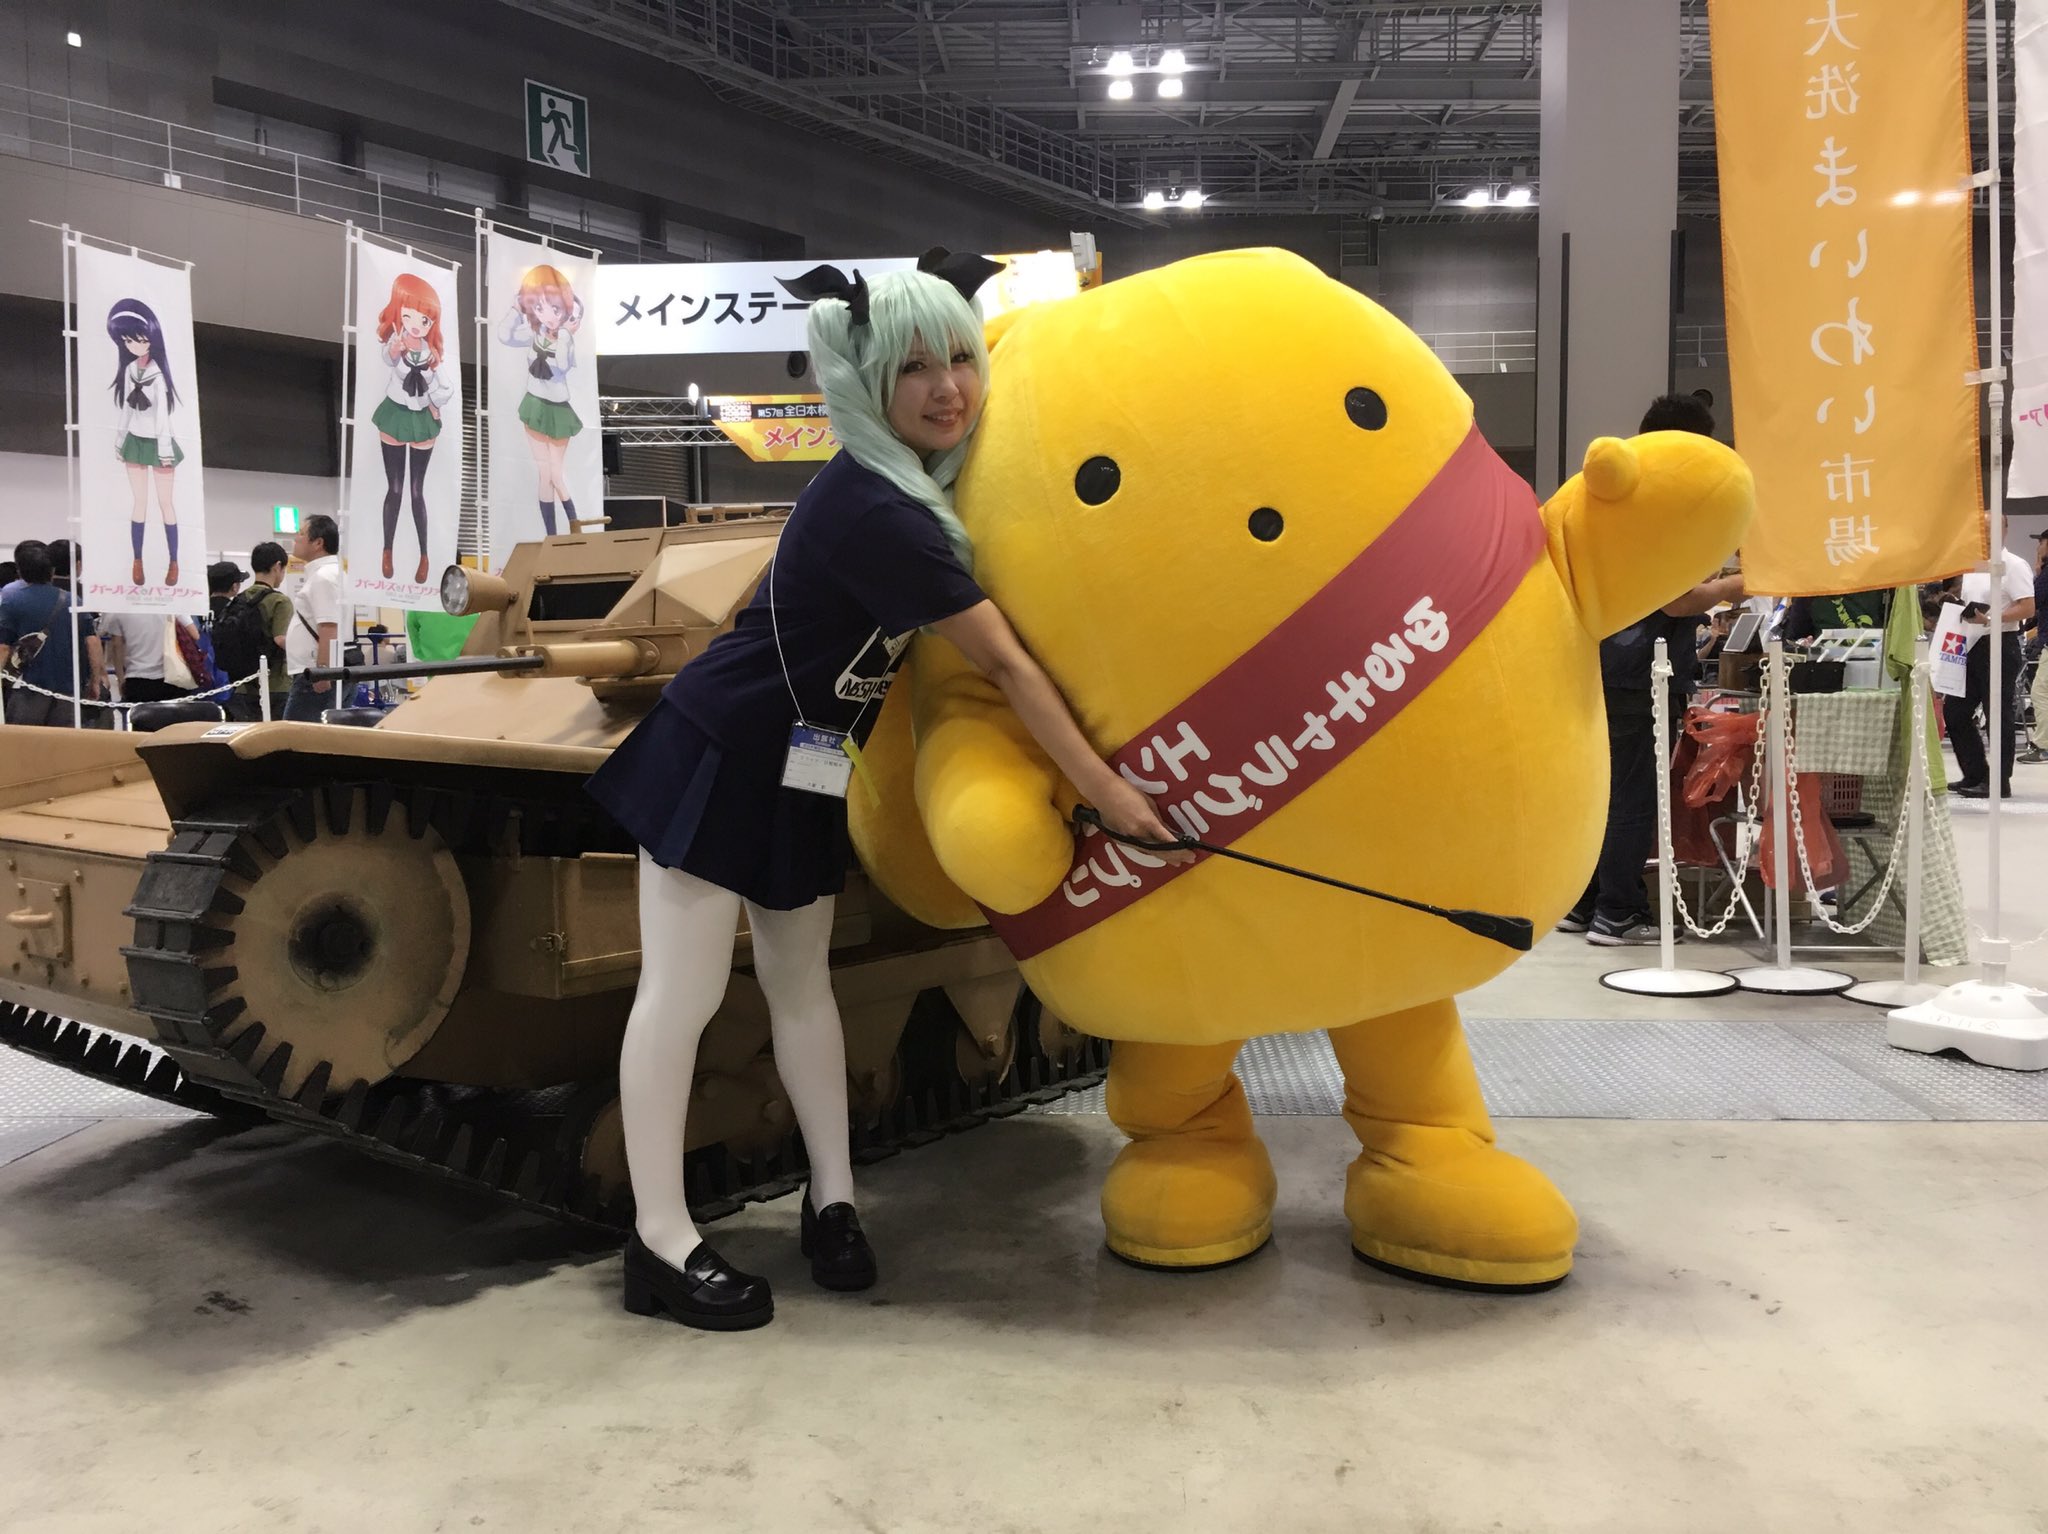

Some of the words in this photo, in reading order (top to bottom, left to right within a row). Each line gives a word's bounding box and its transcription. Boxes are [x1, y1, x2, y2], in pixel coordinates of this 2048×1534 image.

[615, 291, 809, 326] メインステー
